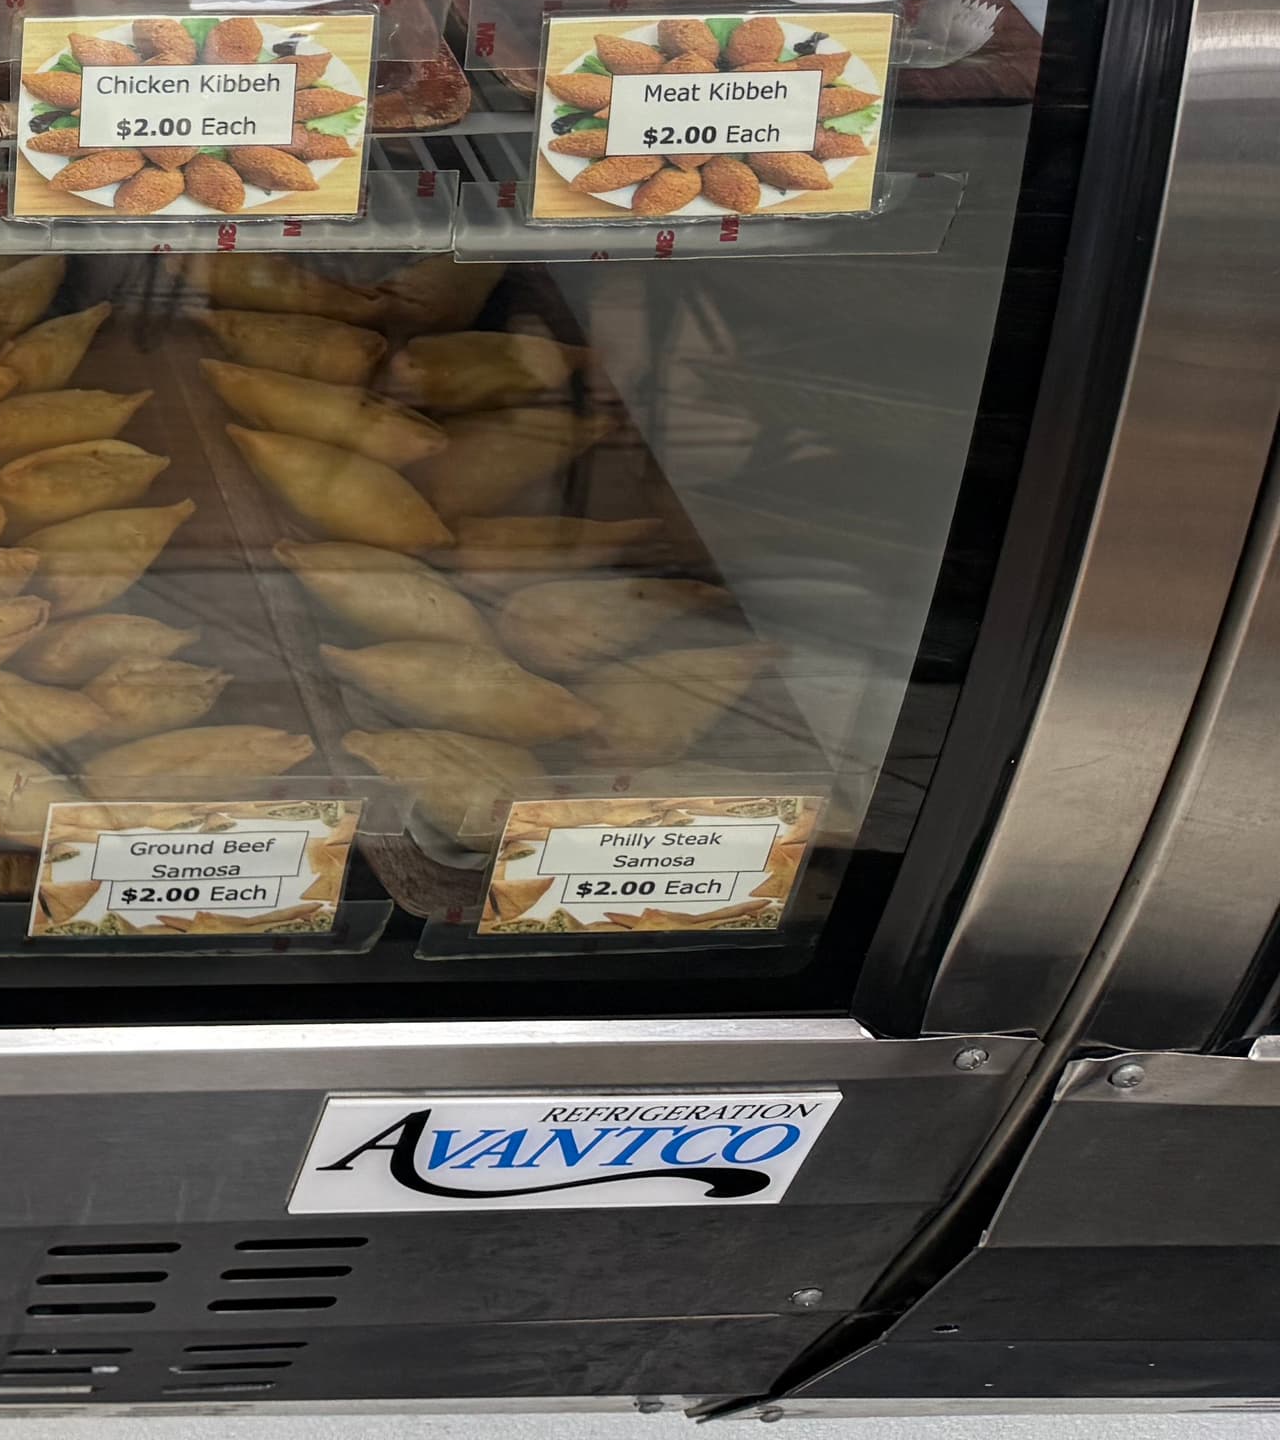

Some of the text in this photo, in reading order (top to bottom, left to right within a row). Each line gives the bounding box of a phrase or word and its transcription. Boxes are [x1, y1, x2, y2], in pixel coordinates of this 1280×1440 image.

[96, 73, 280, 95] Chicken Kibbeh
[644, 81, 788, 102] Meat Kibbeh
[116, 117, 256, 139] $2.00 Each
[642, 124, 780, 149] $2.00 Each
[130, 838, 275, 856] Ground Beef
[599, 832, 722, 848] Philly Steak
[152, 864, 240, 879] Samosa
[613, 855, 695, 868] Samosa
[121, 885, 266, 904] $2.00 Each
[576, 879, 721, 898] $2.00 Each
[539, 1102, 822, 1124] REFRIGERATION
[316, 1108, 801, 1199] AVANTCO
